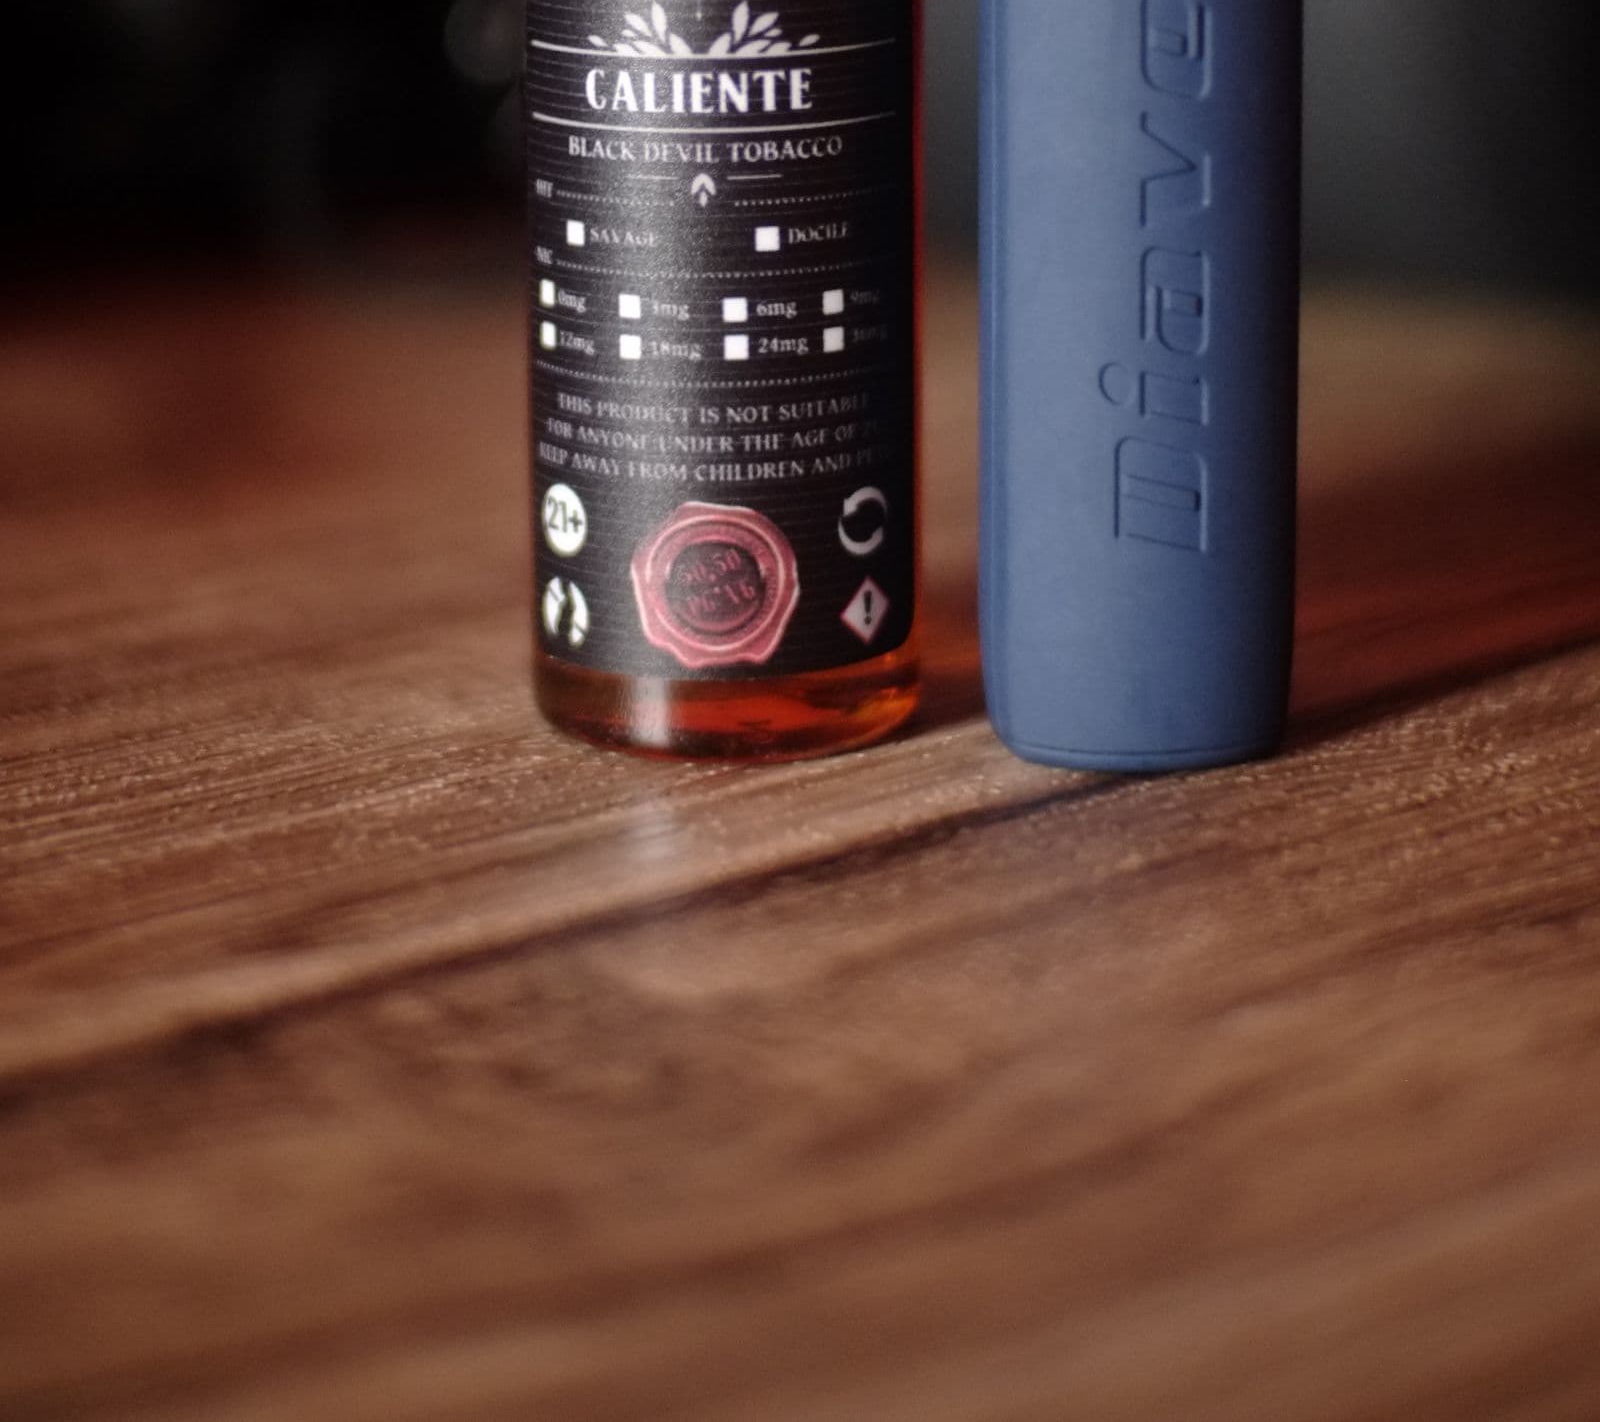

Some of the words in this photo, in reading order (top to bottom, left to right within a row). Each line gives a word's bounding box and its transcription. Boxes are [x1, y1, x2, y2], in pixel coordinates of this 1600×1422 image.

[585, 68, 813, 113] CALIENTE
[568, 135, 637, 161] BLACK
[643, 142, 719, 163] DEVIL
[727, 135, 843, 163] TOBACCO
[756, 300, 798, 319] 6mg
[758, 336, 809, 355] 24mg
[557, 391, 592, 415] THIS
[597, 401, 692, 425] PRODUCT
[700, 407, 720, 424] IS
[726, 405, 771, 423] NOT
[547, 417, 573, 439] FOR
[740, 433, 785, 452] THE
[791, 428, 827, 448] AGE
[834, 423, 857, 442] OF
[539, 441, 569, 465] KEEP
[571, 452, 622, 476] AWAY
[628, 460, 688, 483] FROM
[694, 460, 804, 482] CHILDREN
[811, 452, 852, 474] AND
[547, 495, 583, 533] 21+
